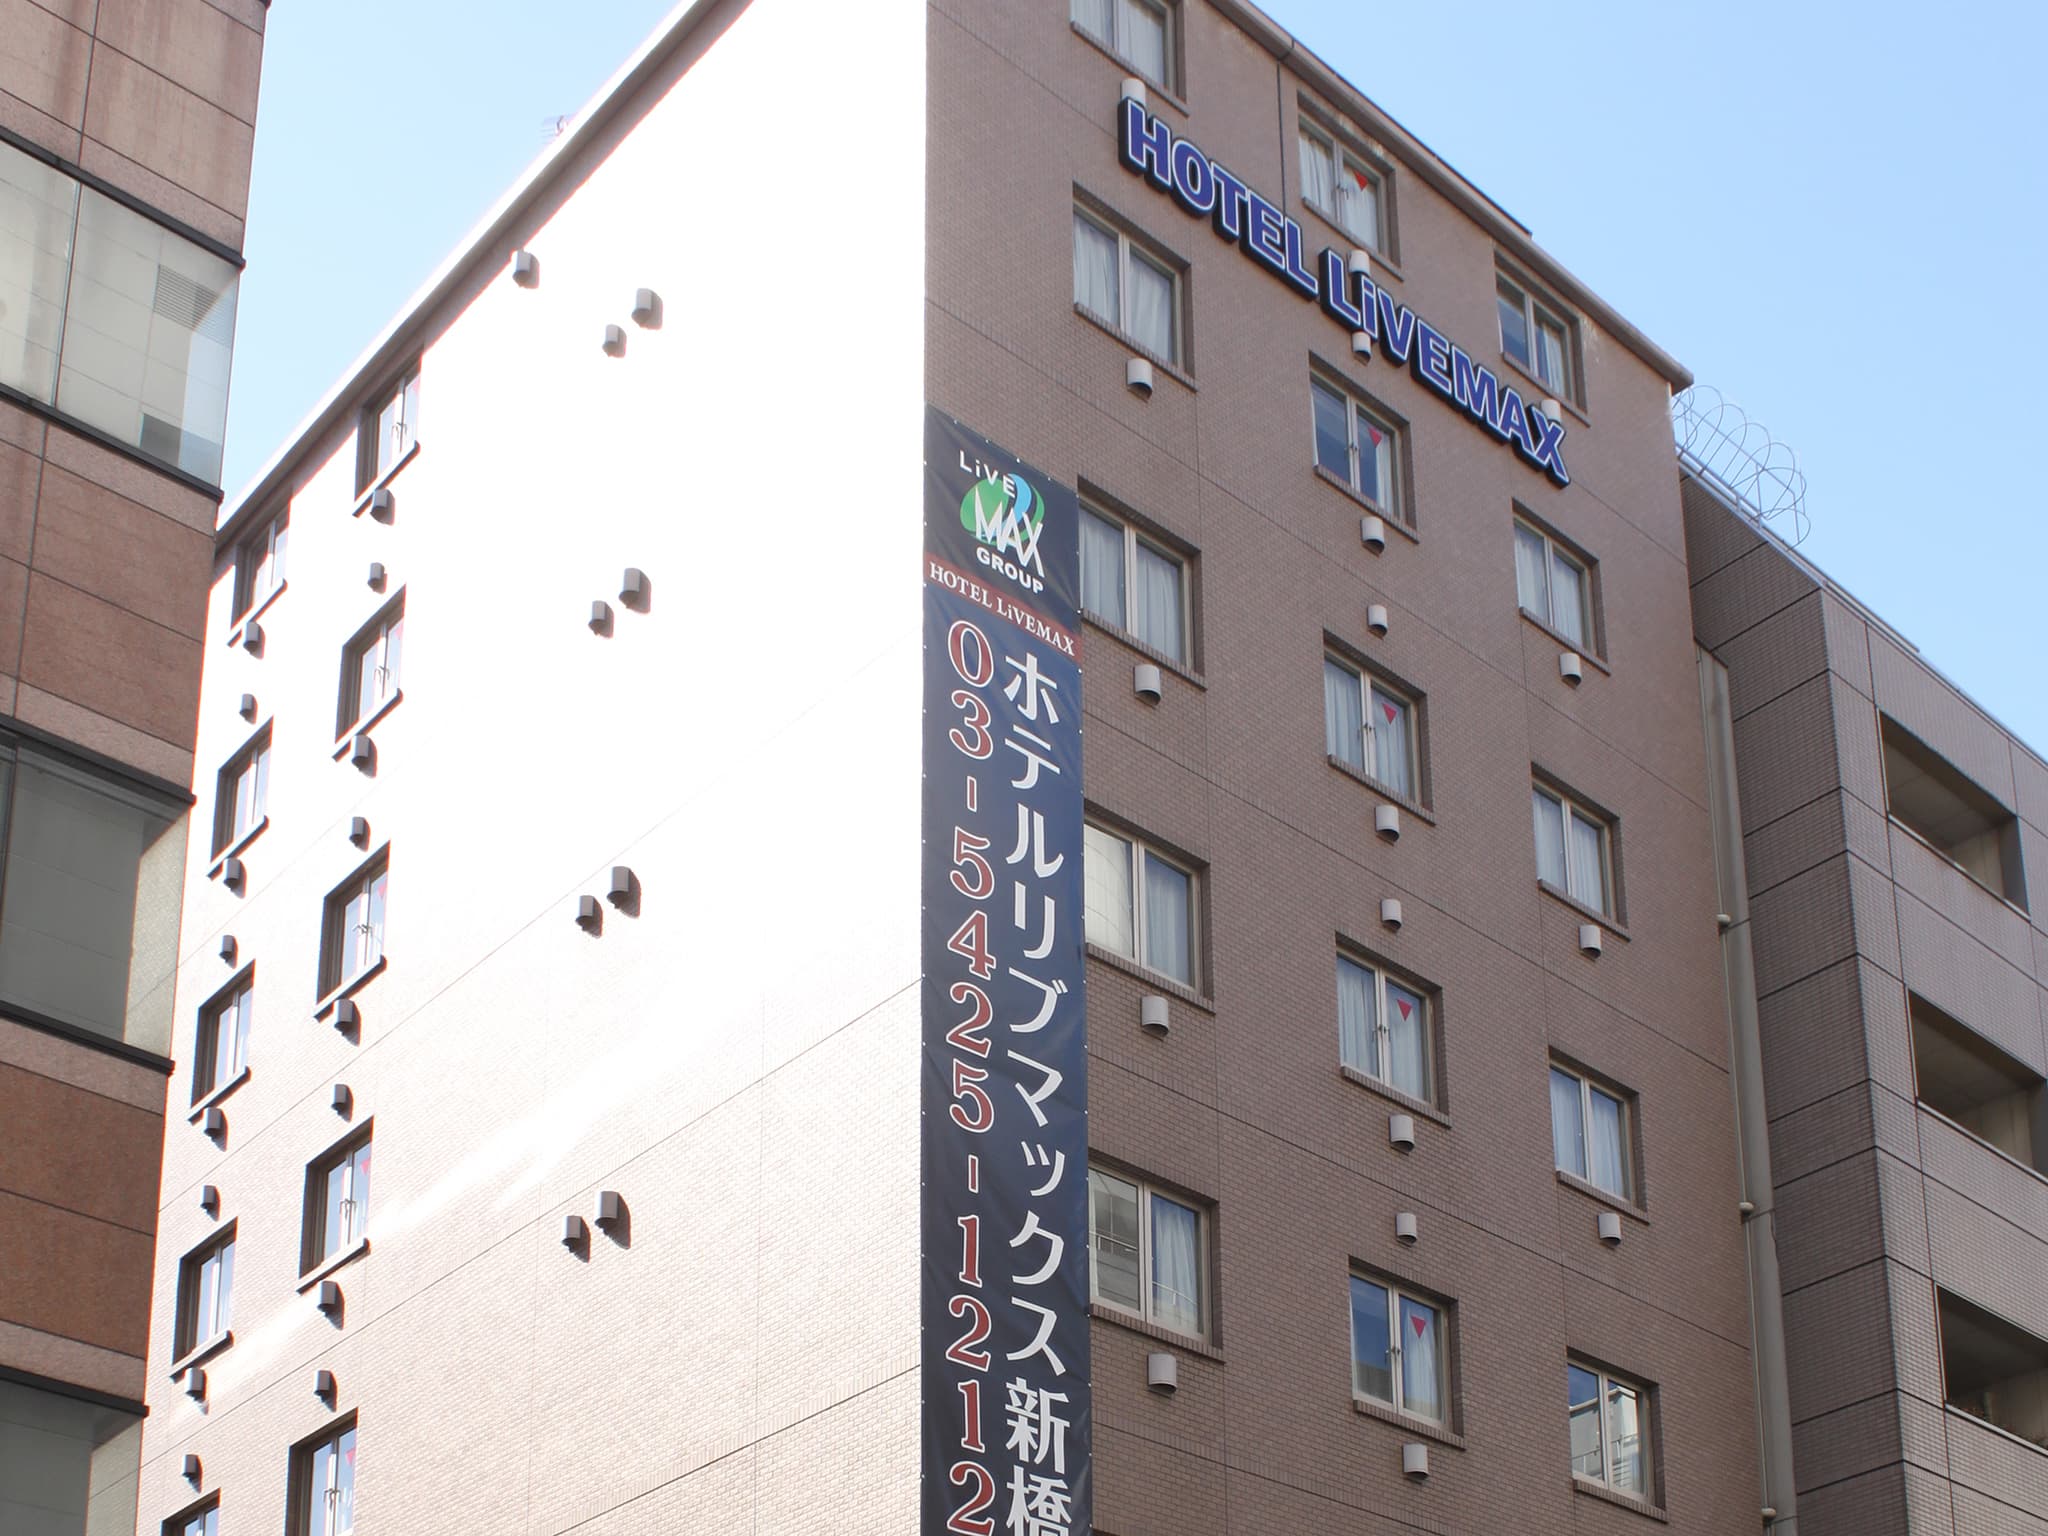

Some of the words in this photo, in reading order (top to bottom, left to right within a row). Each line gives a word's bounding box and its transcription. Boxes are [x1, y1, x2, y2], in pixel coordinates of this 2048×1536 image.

[1119, 98, 1319, 301] HOTEL
[1320, 246, 1570, 487] LiVEMAX
[959, 450, 1016, 498] LiVE
[974, 485, 1045, 578] MAX
[976, 546, 1044, 594] GROUP
[929, 561, 993, 609] HOTEL
[997, 597, 1076, 657] LiVEMAX
[946, 619, 997, 1536] 03-5425-1212
[1004, 652, 1073, 1536] ホテルリブマックス新橋
